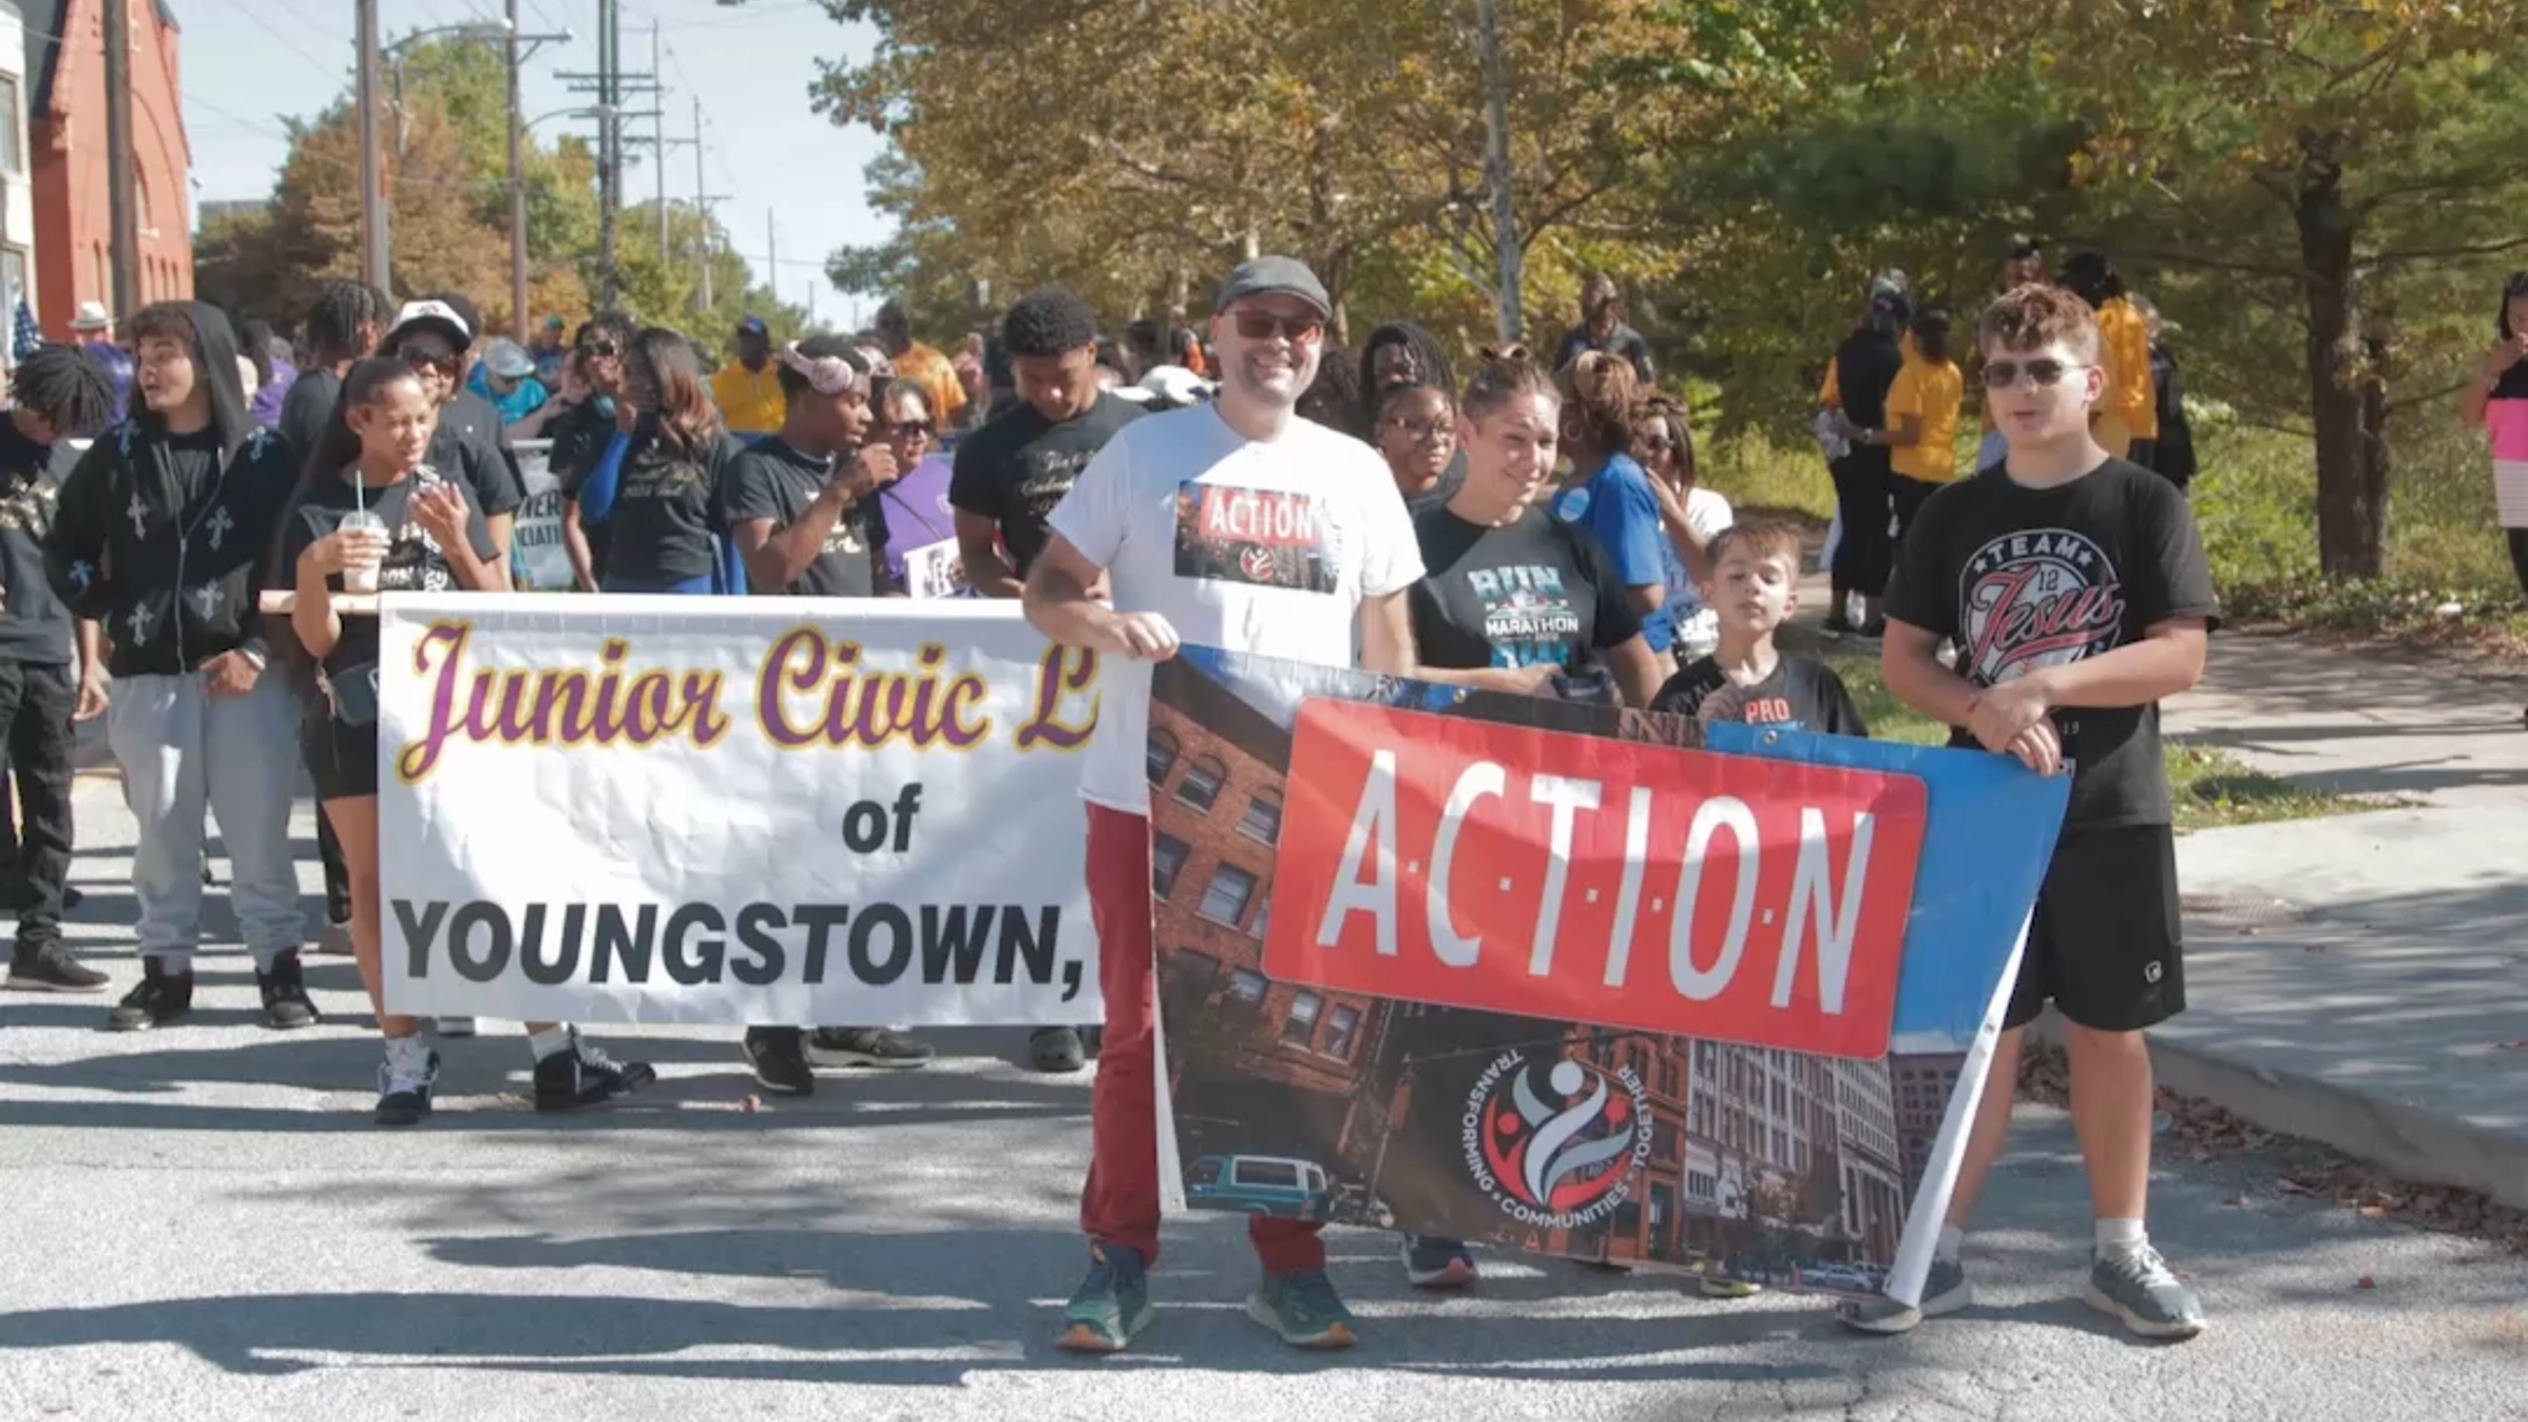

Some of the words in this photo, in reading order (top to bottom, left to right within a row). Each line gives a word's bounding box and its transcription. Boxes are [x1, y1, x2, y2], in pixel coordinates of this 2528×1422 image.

[1988, 534, 2081, 564] TEAM
[2038, 569, 2060, 593] 12
[1485, 617, 1579, 637] MARATHON
[1968, 563, 2125, 679] Jesus
[397, 619, 730, 783] Junior
[756, 623, 992, 751] Civic
[1745, 697, 1791, 724] PRO
[841, 781, 923, 854] of
[390, 899, 1085, 1002] YOUNGSTOWN,
[1462, 1048, 1524, 1192] TRANSFORMING
[1501, 1181, 1630, 1229] COMMUNITIES
[1616, 1063, 1655, 1168] TOGETHER
